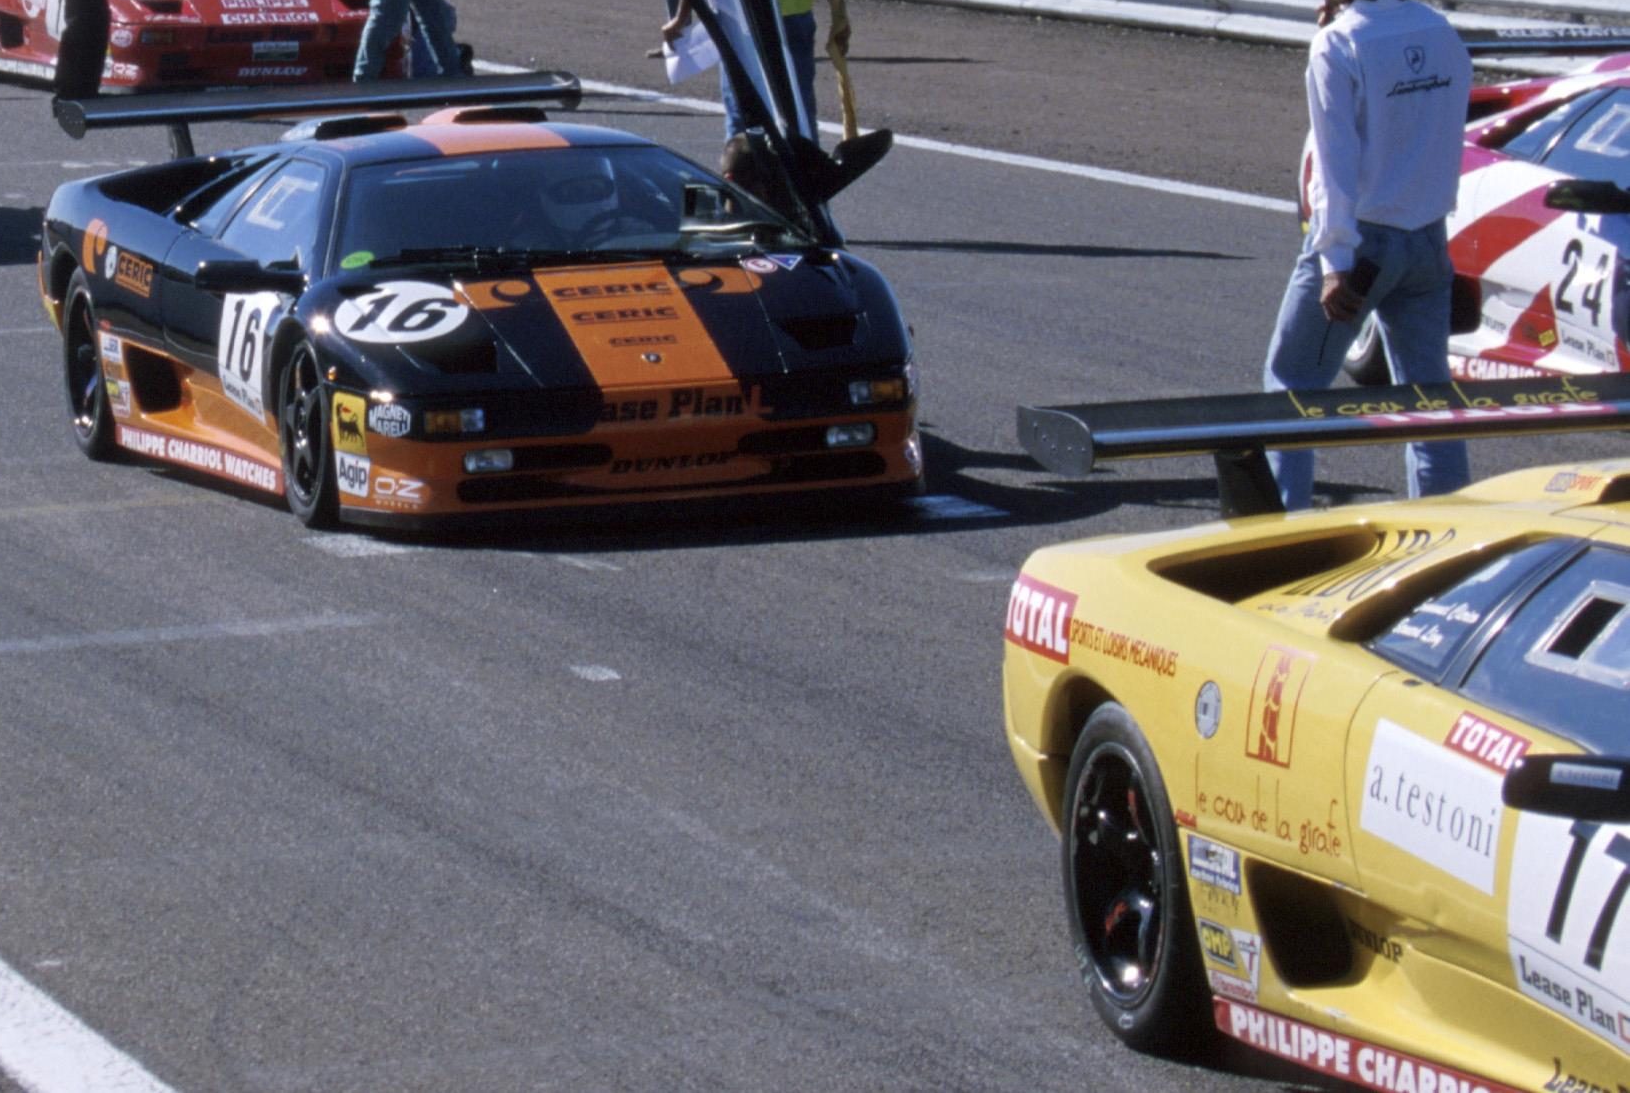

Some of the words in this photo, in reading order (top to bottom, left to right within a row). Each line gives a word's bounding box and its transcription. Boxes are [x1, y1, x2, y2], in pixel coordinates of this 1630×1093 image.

[222, 13, 319, 24] CHARRIOL
[237, 66, 308, 76] DUNLOP
[121, 254, 153, 287] CERIC
[554, 280, 672, 297] CERIC
[1555, 238, 1610, 327] 24
[347, 293, 457, 332] 16
[572, 307, 678, 322] CERIC
[226, 300, 262, 382] 16
[610, 334, 676, 346] CERIC
[669, 388, 745, 418] Plan
[1286, 390, 1325, 417] le
[1412, 382, 1449, 411] de
[1450, 380, 1496, 407] la
[1513, 376, 1599, 405] girafe
[121, 427, 166, 457] PHILIPPE
[168, 439, 223, 470] CHARRIOL
[224, 454, 277, 491] WATCHES
[339, 457, 367, 490] Agip
[1007, 580, 1068, 655] TOTAL
[1071, 618, 1094, 648] SPORTS
[1451, 714, 1525, 769] TOTAL
[1196, 752, 1207, 813] le
[1214, 796, 1246, 824] cou
[1252, 774, 1268, 831] de
[1275, 778, 1291, 841] la
[1299, 799, 1341, 857] girafe
[1370, 764, 1497, 857] a.testoni
[1546, 818, 1630, 972] 17
[1519, 954, 1572, 1008] Lease
[1576, 987, 1617, 1034] Plan
[1230, 1004, 1351, 1074] PHILIPPE
